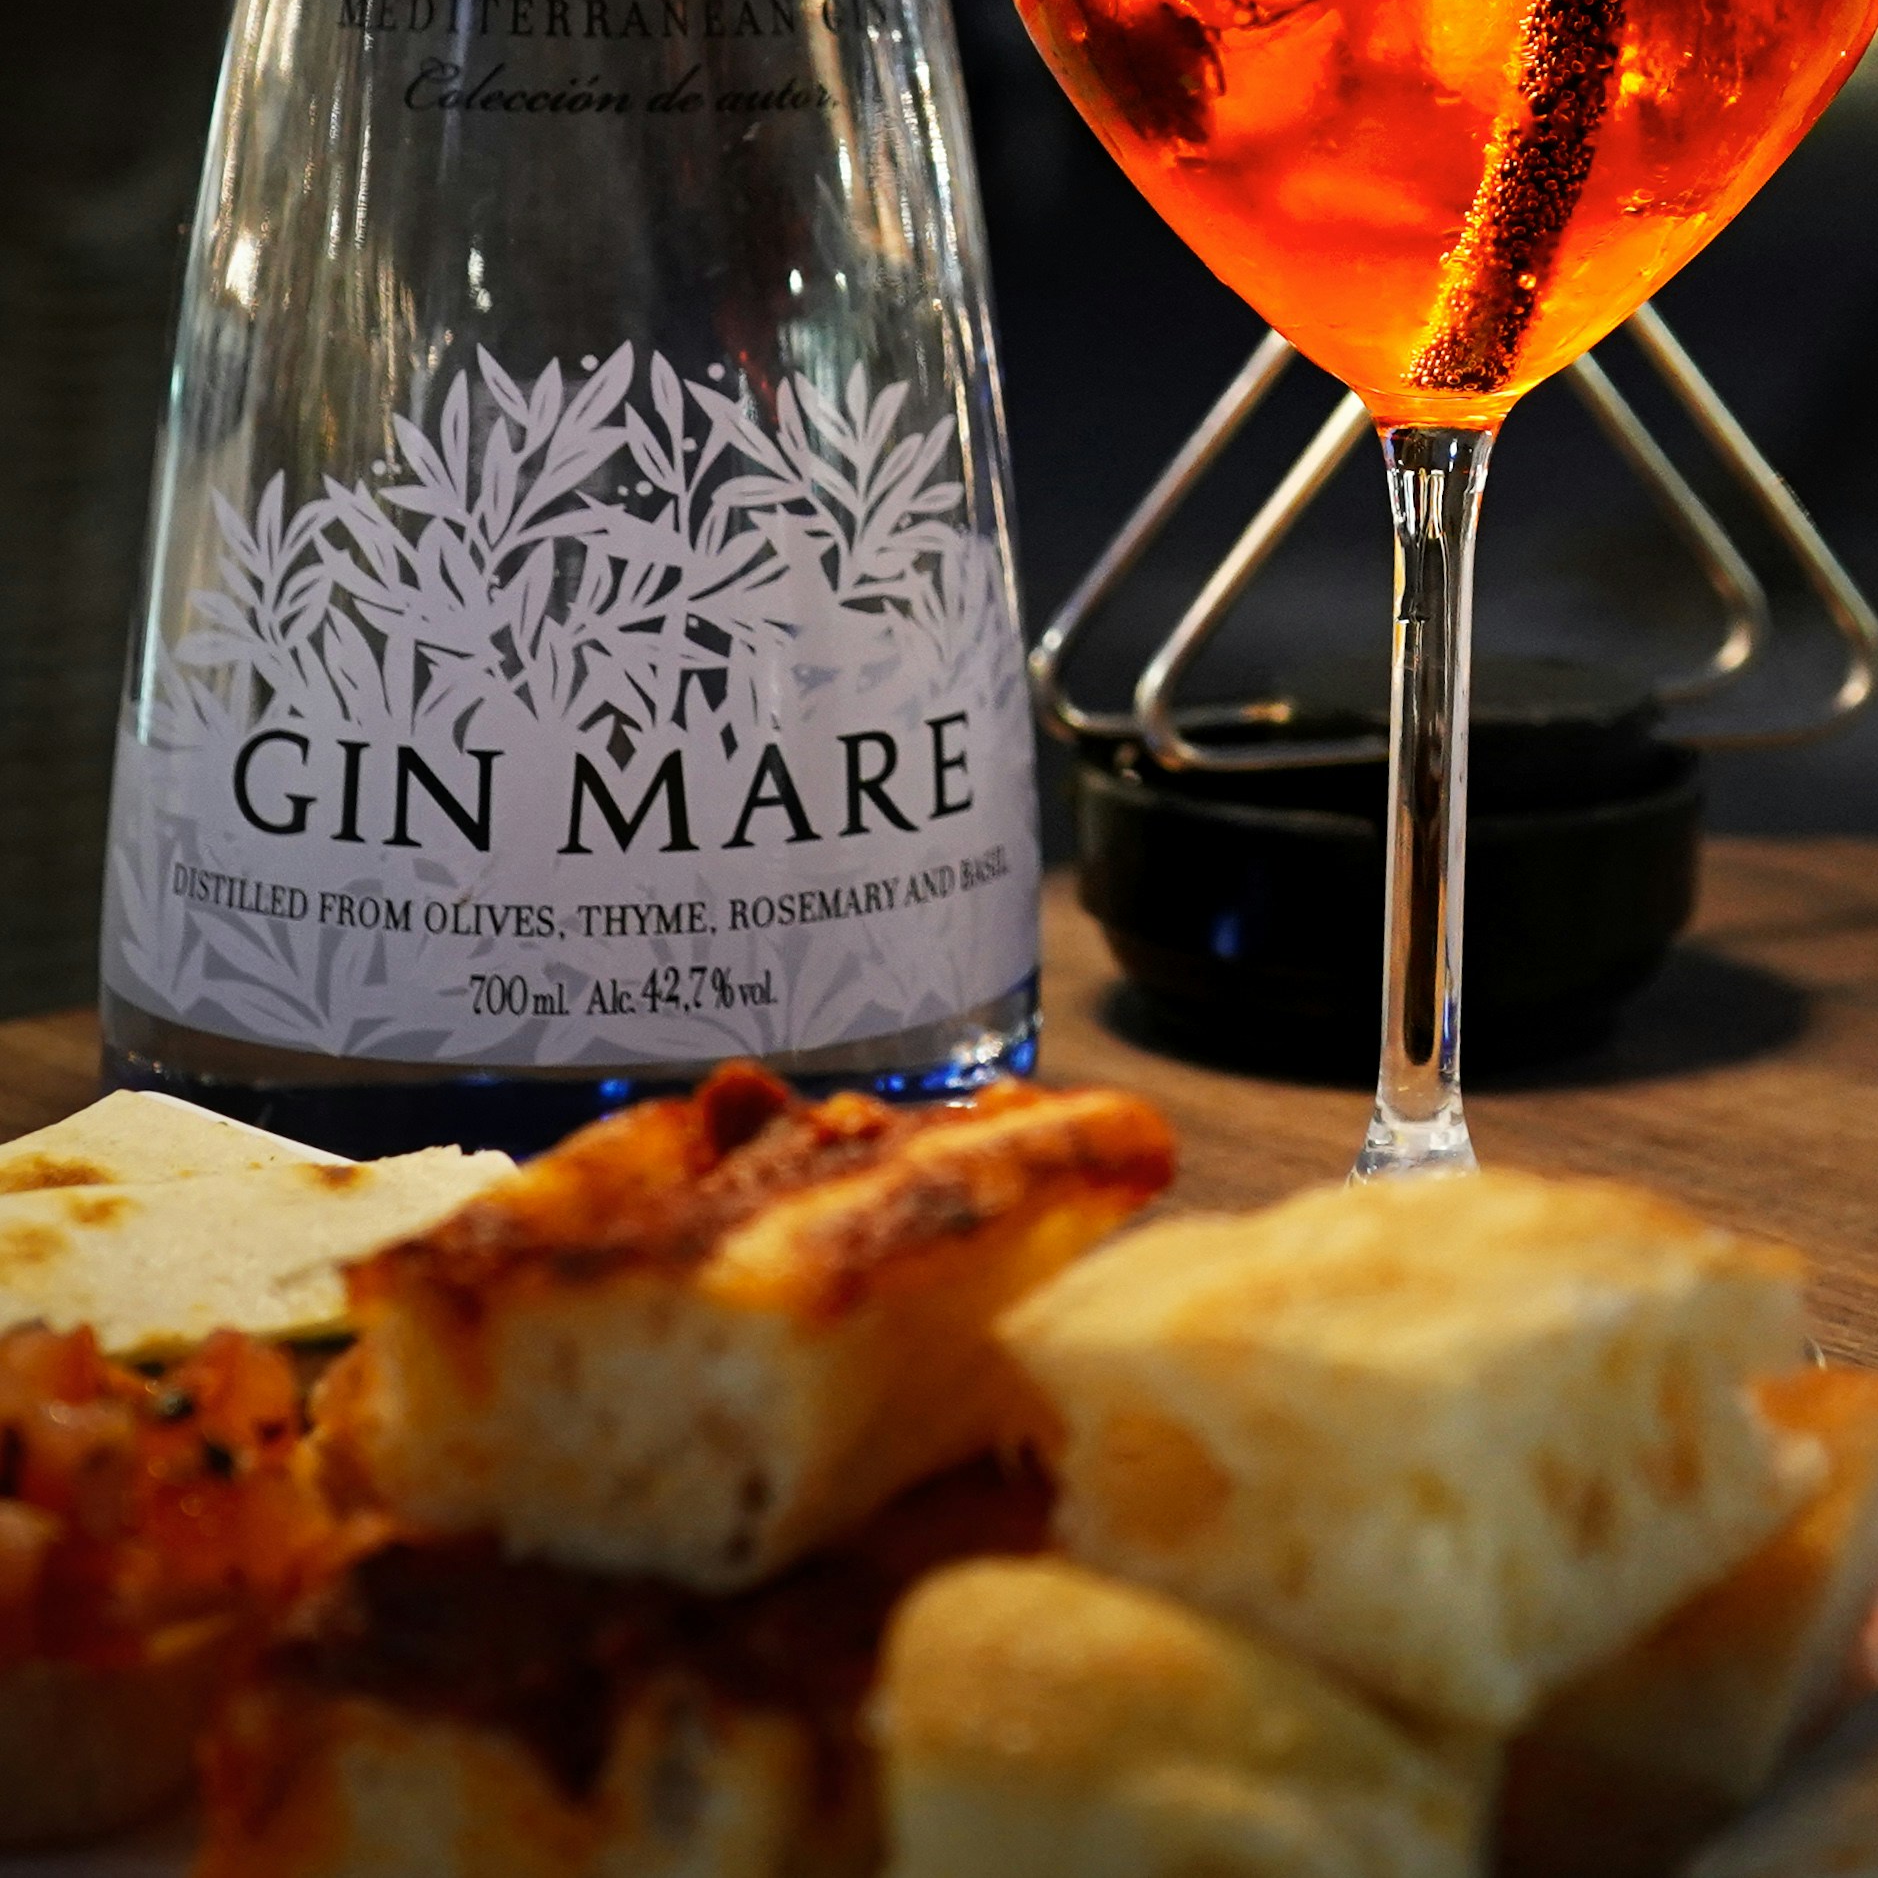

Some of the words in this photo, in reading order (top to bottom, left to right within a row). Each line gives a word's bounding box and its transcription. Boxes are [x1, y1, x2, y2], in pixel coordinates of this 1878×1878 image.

[404, 56, 630, 113] Colección
[646, 62, 704, 113] de
[233, 728, 505, 852] GIN
[557, 710, 974, 854] MARE
[172, 862, 308, 921] DISTILLED
[318, 891, 412, 932] FROM
[424, 901, 566, 940] OLIVES,
[578, 901, 717, 936] THYME,
[728, 876, 899, 931] ROSEMARY
[903, 864, 956, 907] AND
